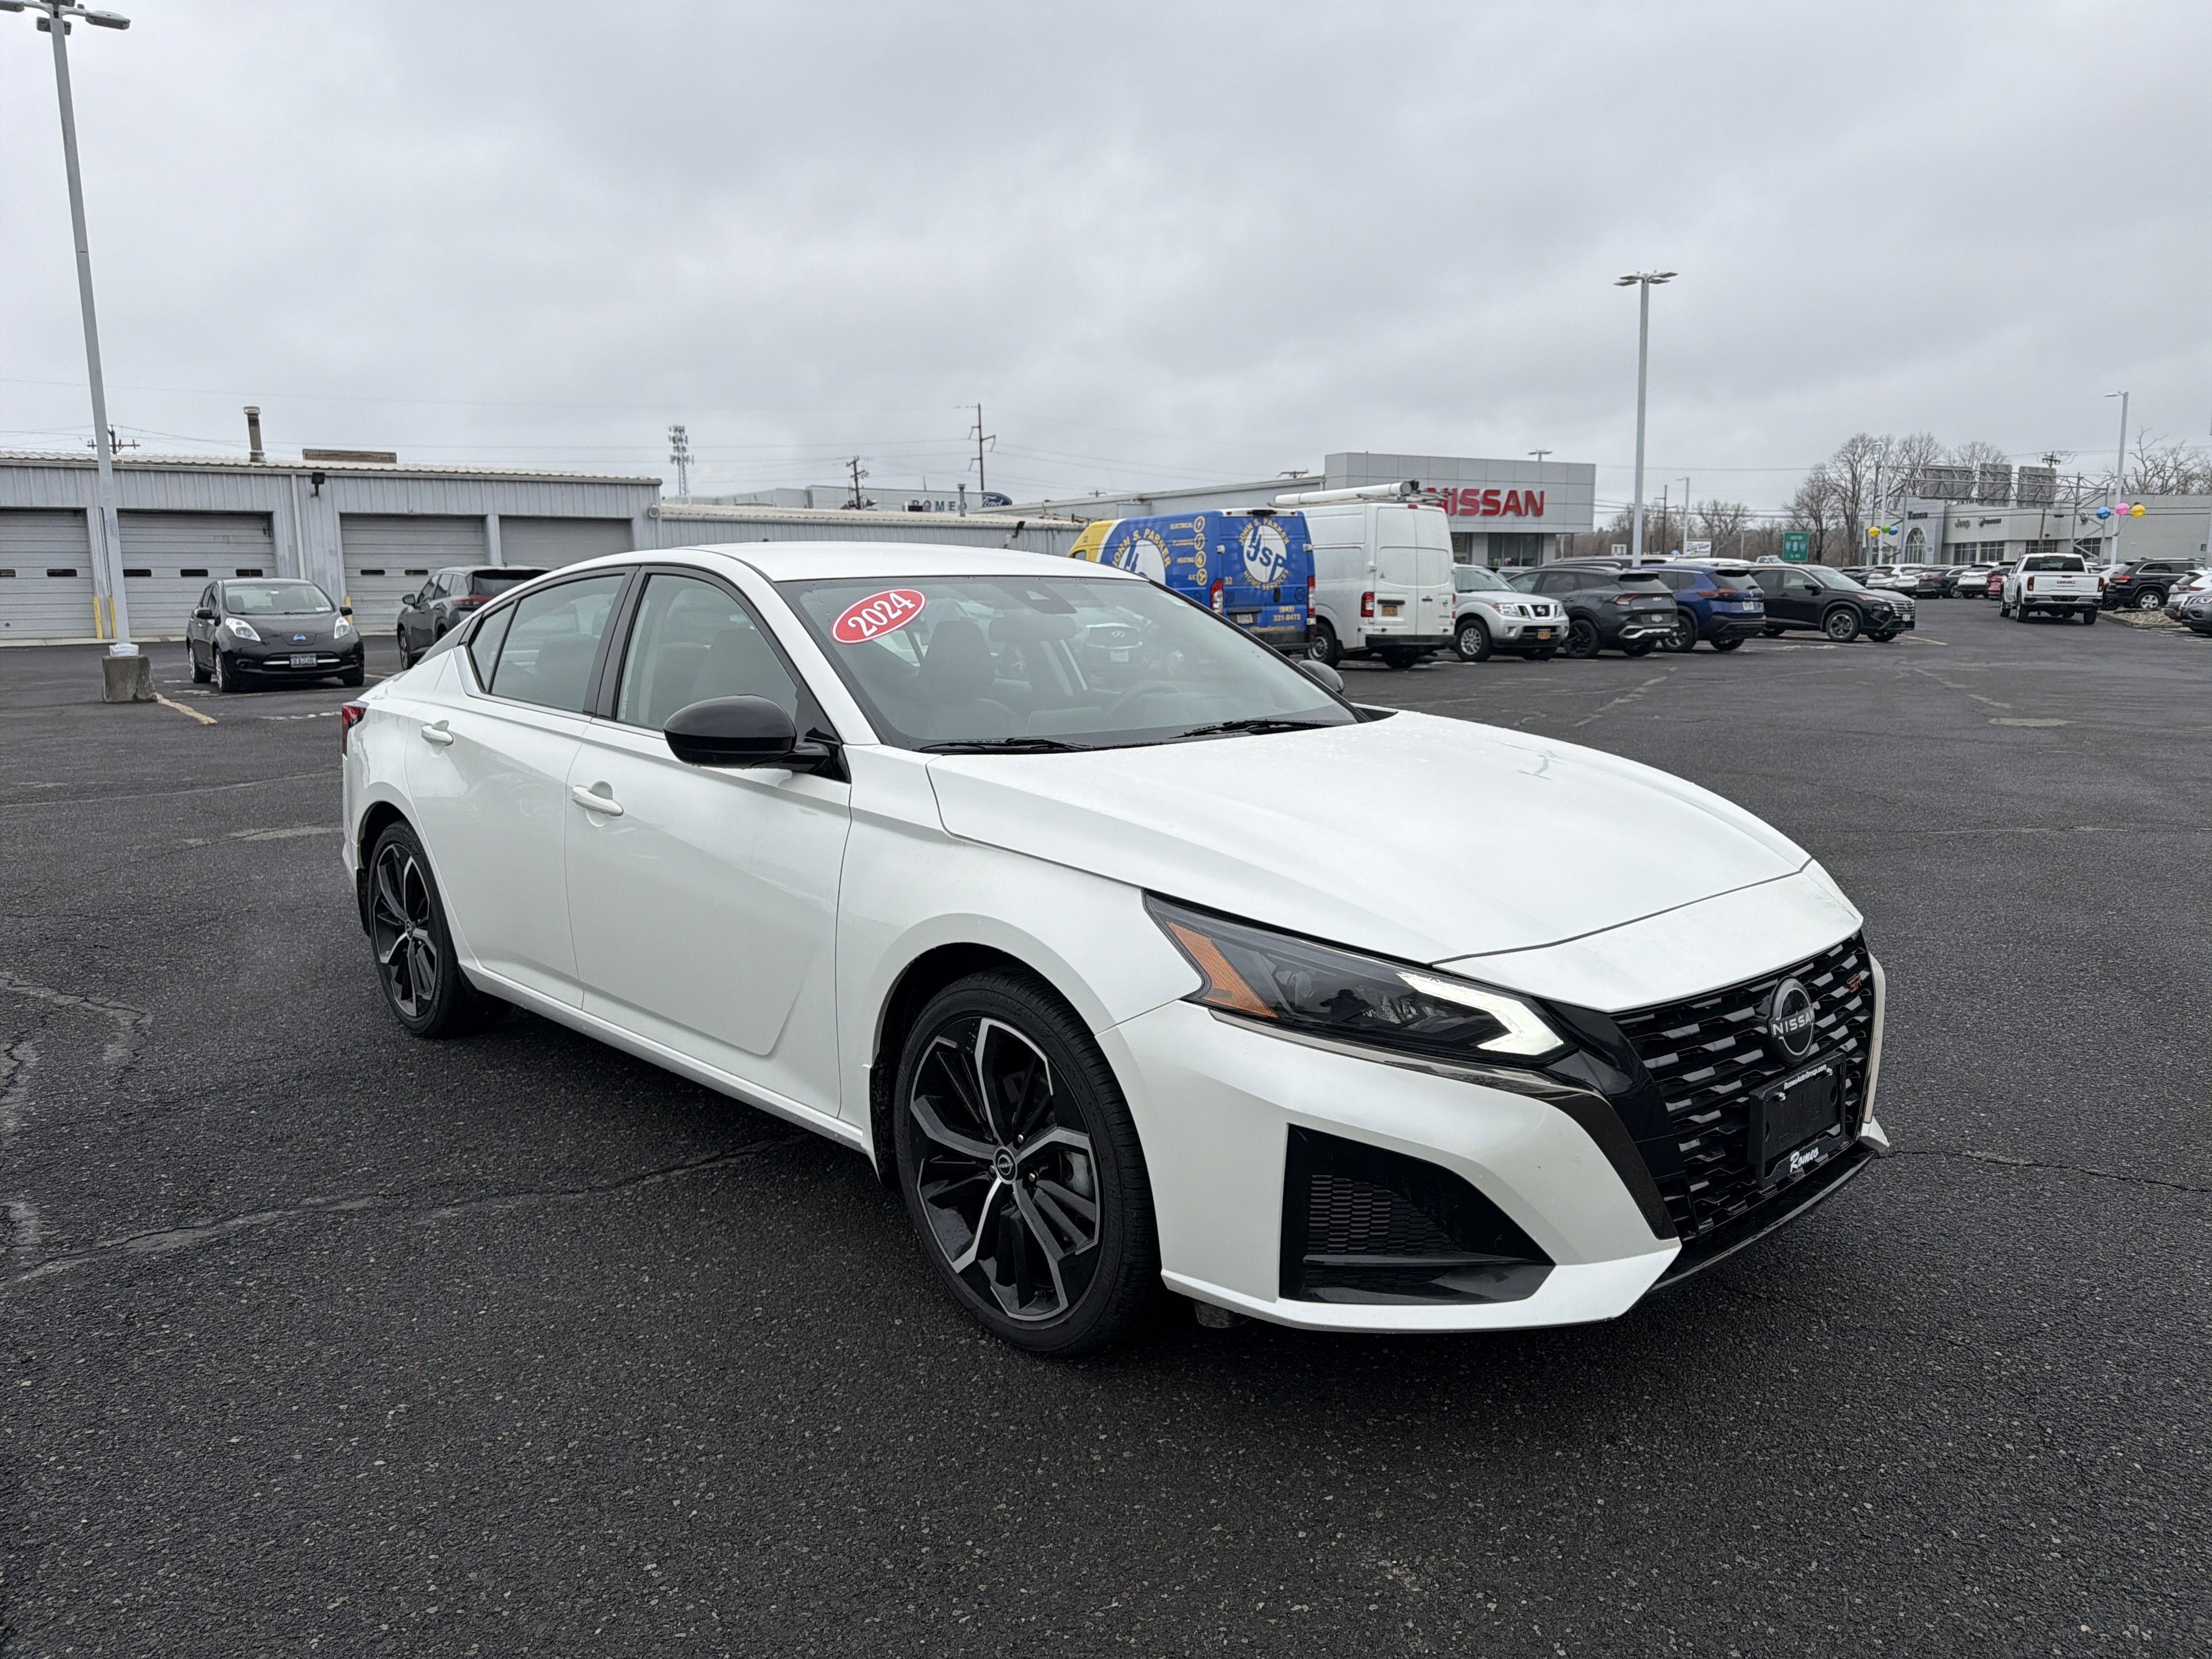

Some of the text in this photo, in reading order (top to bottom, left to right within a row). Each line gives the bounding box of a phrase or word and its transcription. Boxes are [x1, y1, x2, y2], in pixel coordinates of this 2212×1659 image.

[982, 495, 1003, 508] Ford
[1263, 518, 1290, 545] PARKER
[1143, 528, 1171, 568] PARKER
[848, 592, 915, 636] 2024
[1772, 1009, 1815, 1036] NISSAN
[1790, 1147, 1819, 1173] Romeo
